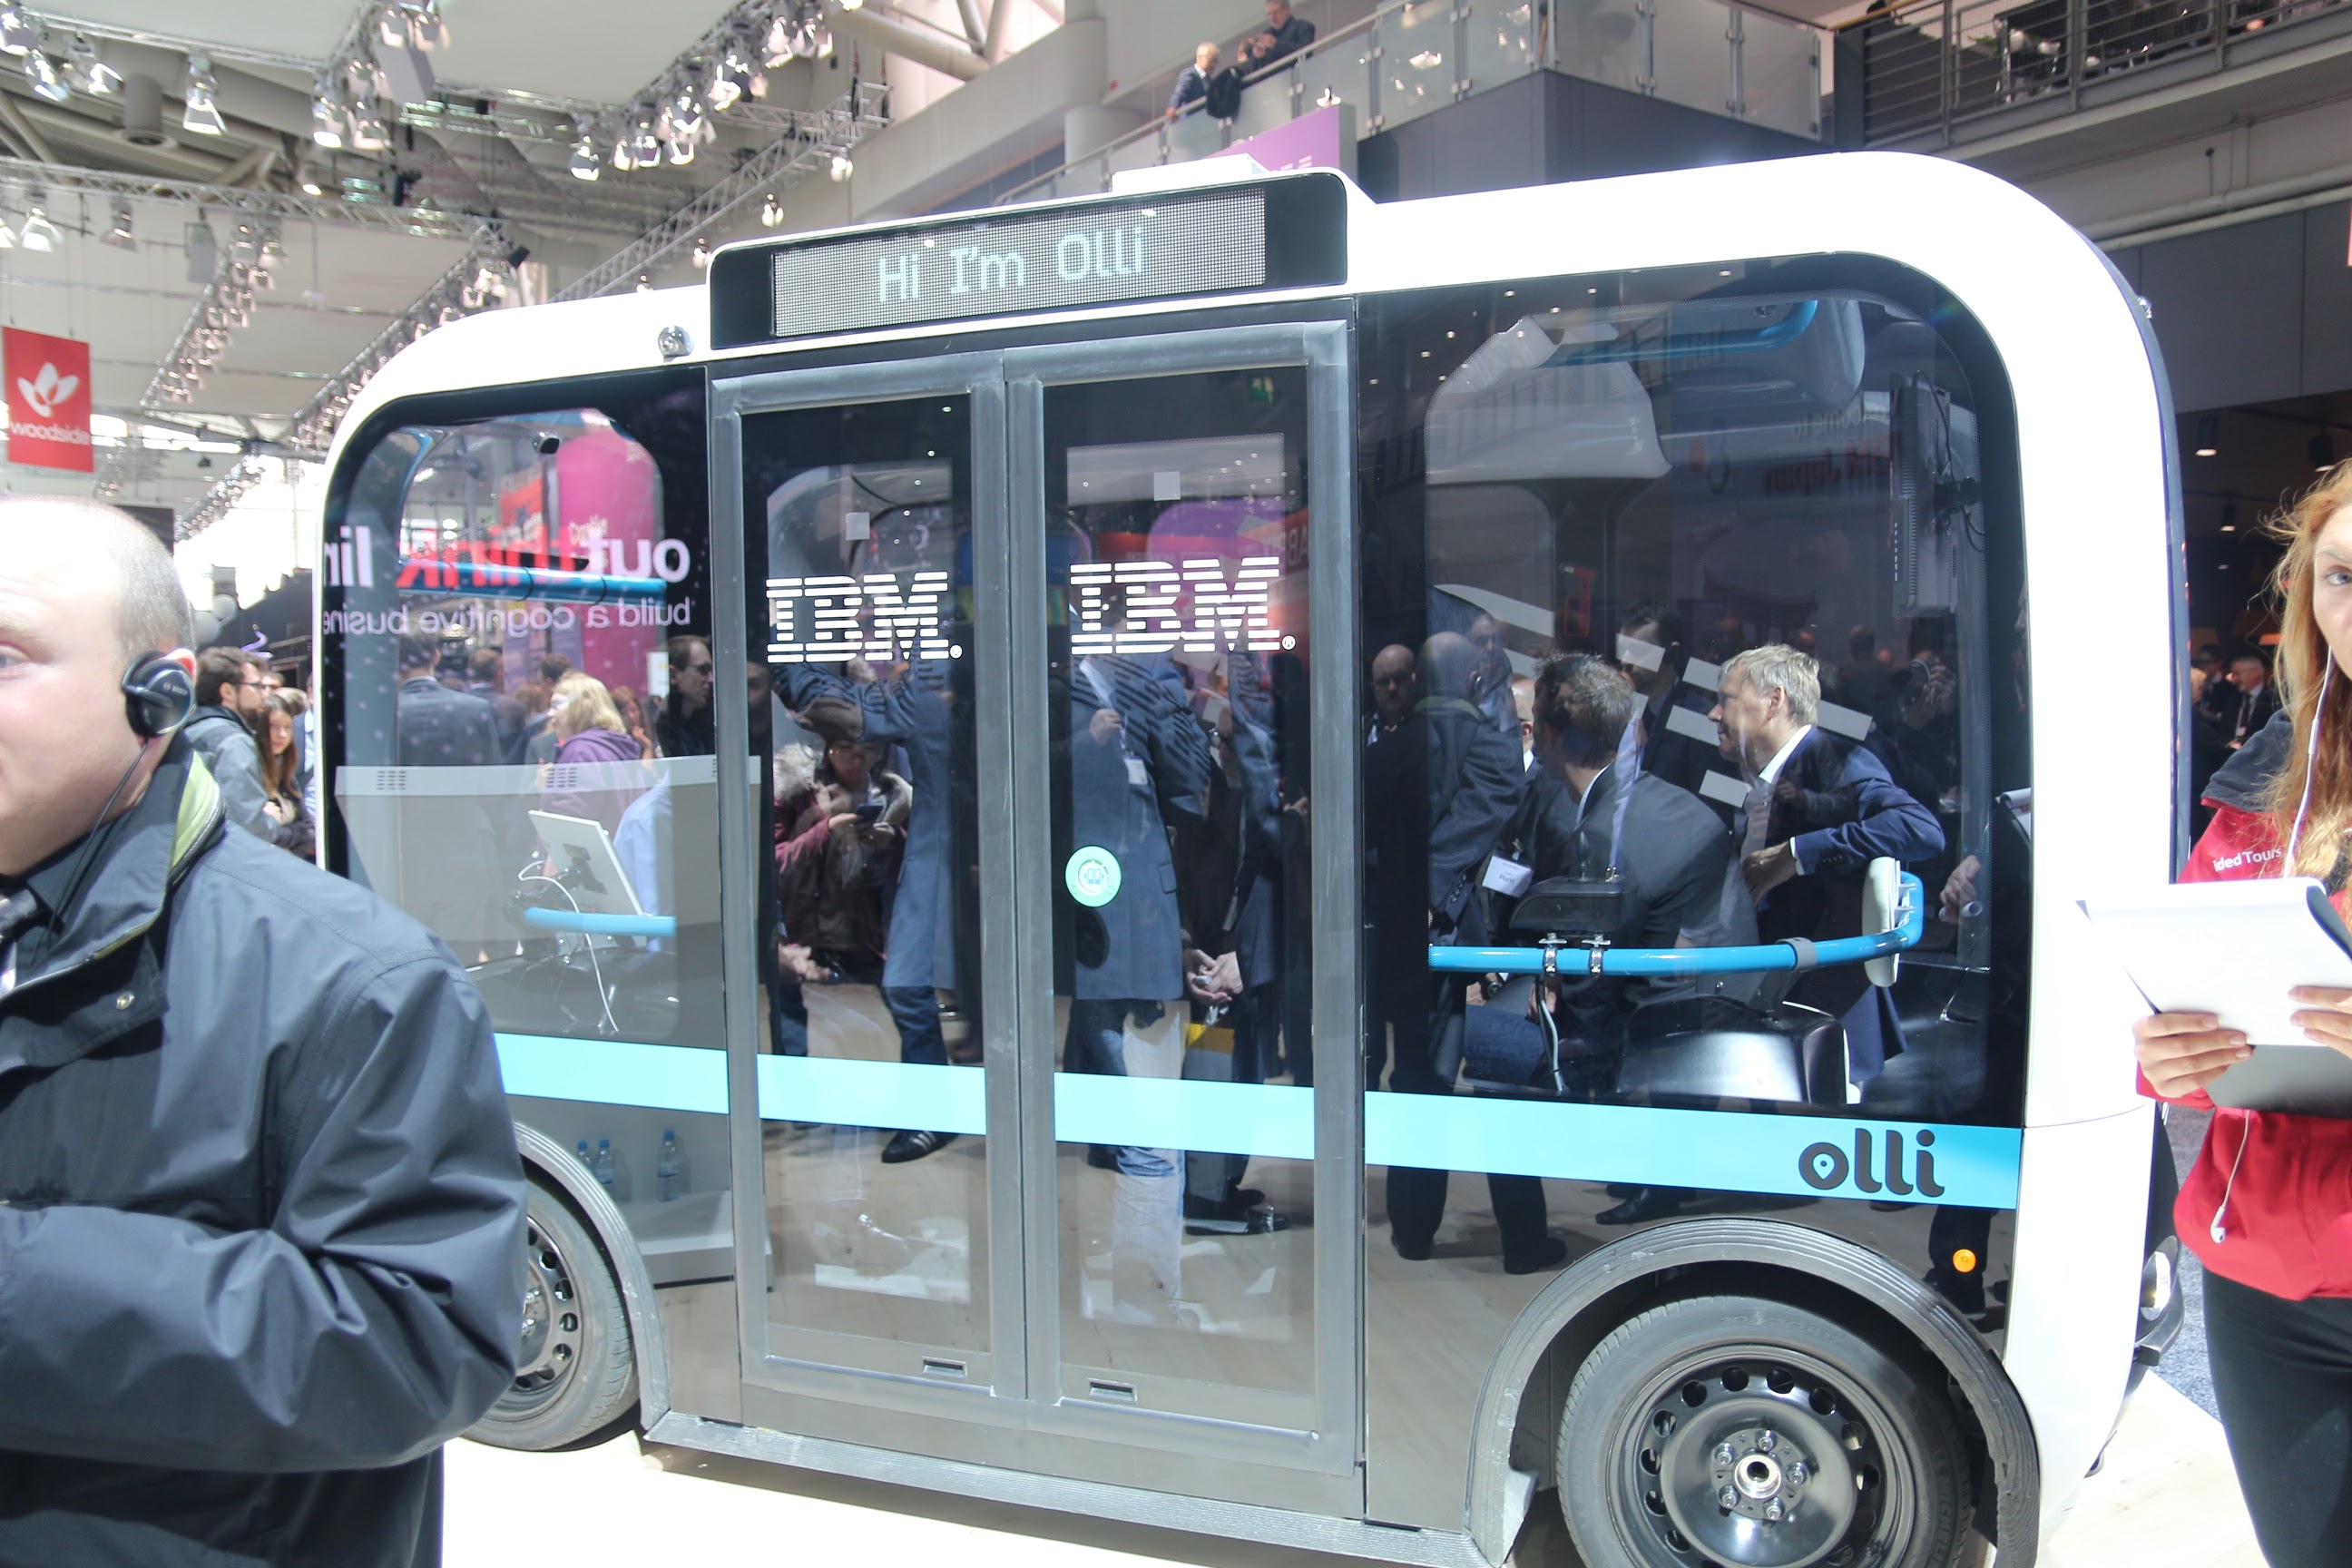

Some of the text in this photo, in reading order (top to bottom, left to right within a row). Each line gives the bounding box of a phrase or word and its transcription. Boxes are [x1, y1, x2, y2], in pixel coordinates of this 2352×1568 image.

[878, 226, 1142, 302] Hi I'm Olli
[9, 421, 92, 446] woodside
[2242, 847, 2283, 864] Tours
[1798, 1127, 1945, 1199] olli
